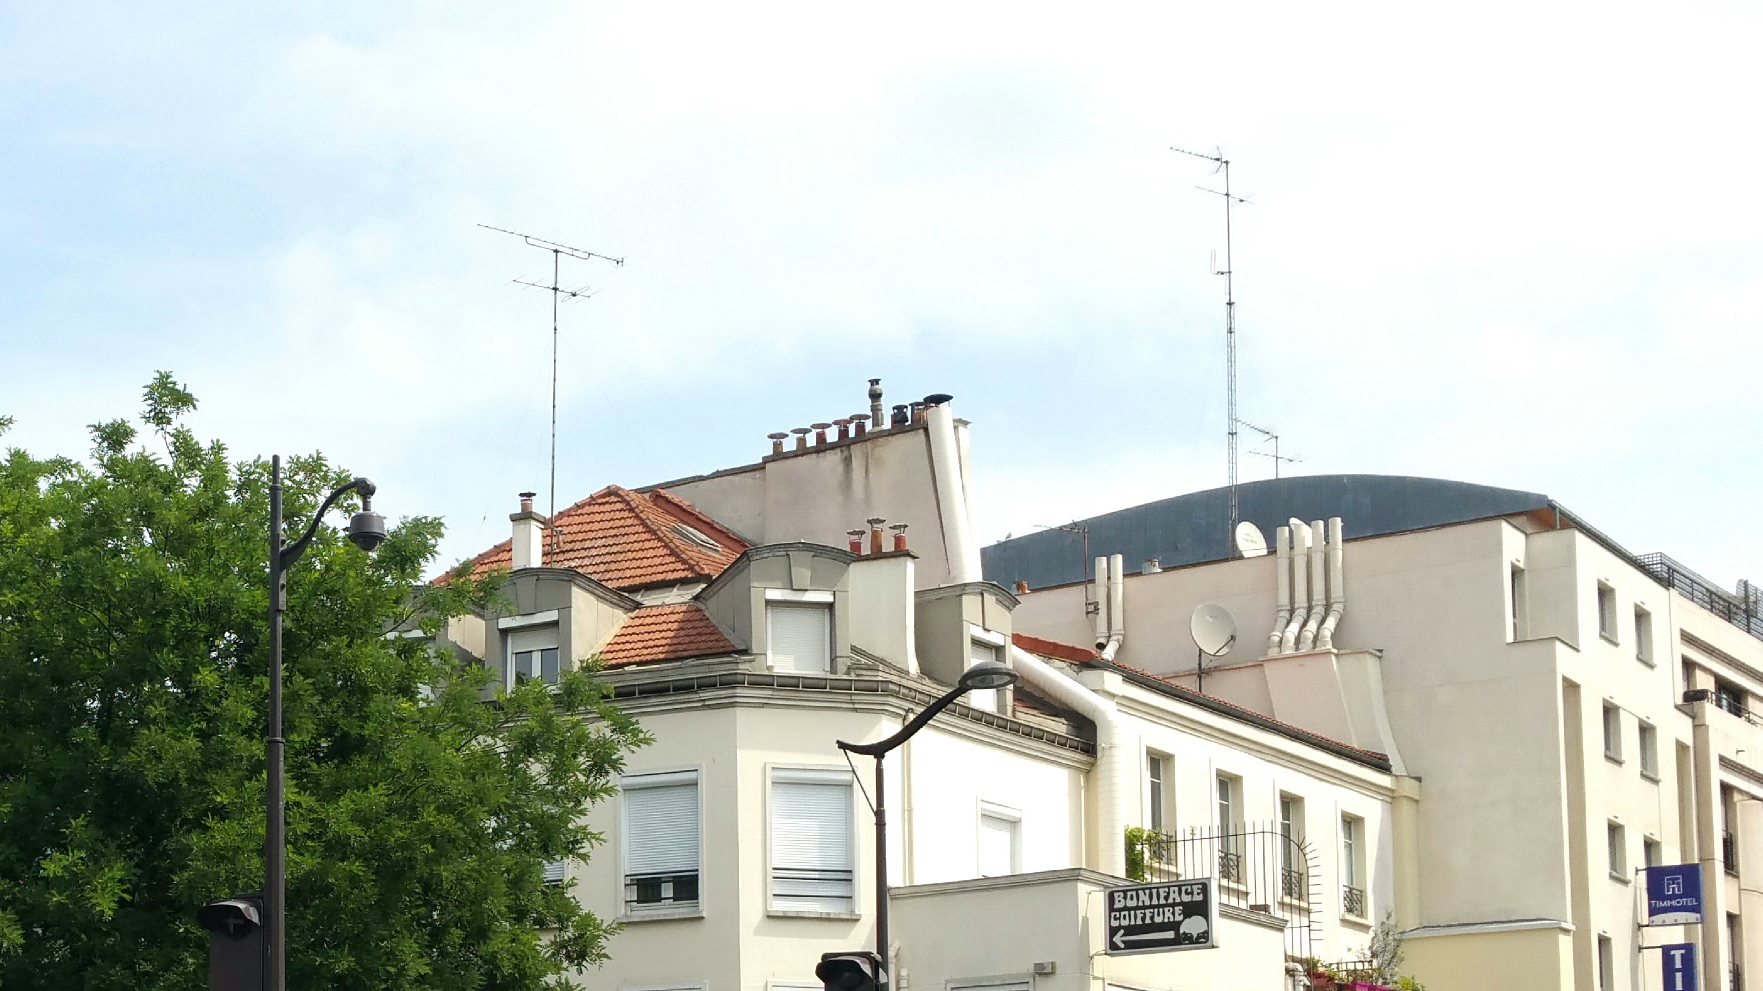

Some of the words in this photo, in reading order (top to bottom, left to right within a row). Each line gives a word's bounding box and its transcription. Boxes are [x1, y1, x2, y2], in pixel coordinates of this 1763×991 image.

[1113, 884, 1204, 909] BONIFACE
[1650, 898, 1698, 908] TIMHOTEL
[1110, 905, 1184, 927] COIFFURE
